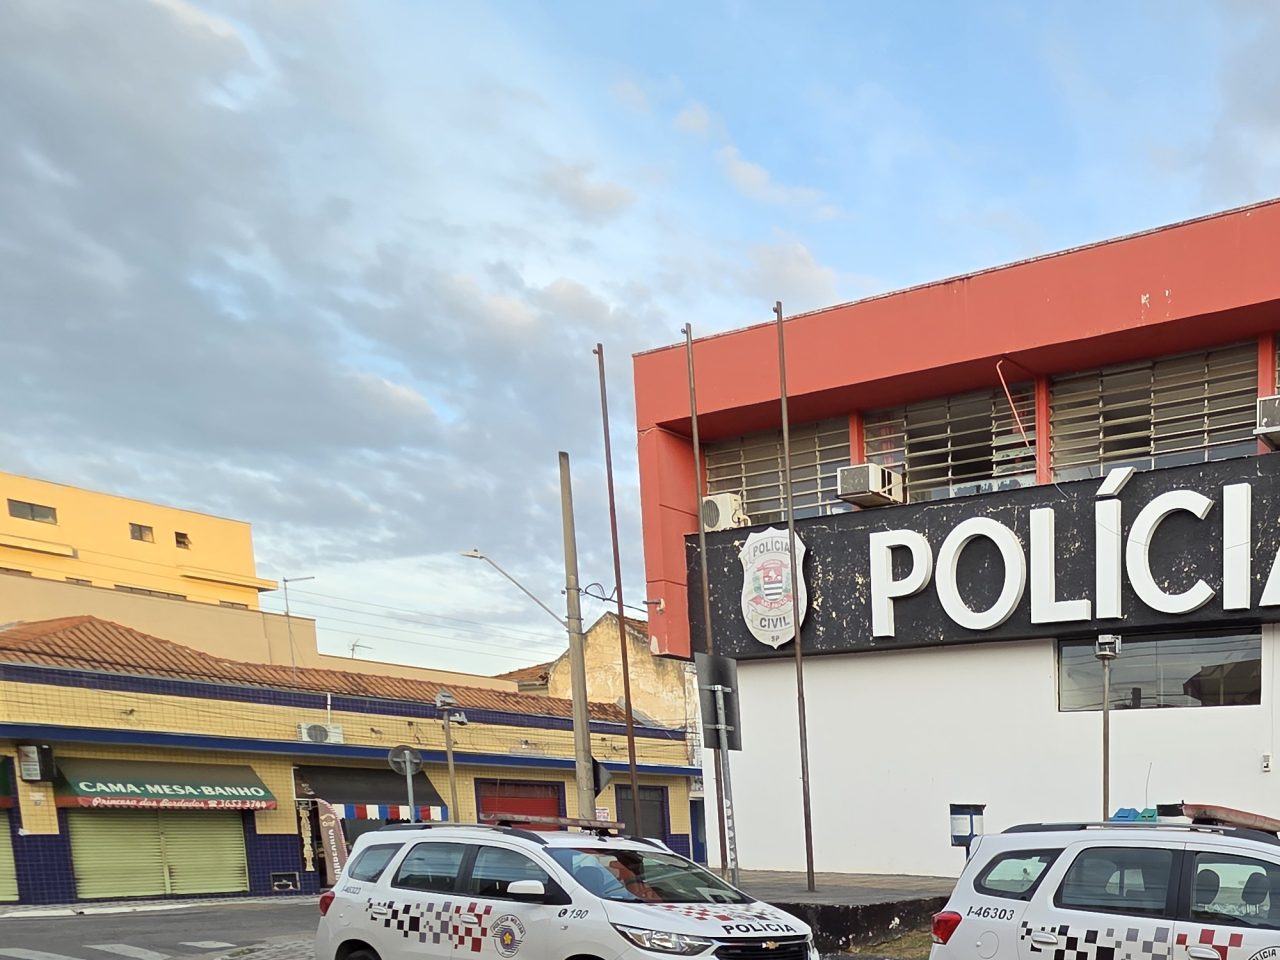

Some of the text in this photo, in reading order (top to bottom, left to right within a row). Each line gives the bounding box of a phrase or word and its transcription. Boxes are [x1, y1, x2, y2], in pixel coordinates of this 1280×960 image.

[752, 537, 790, 557] POLÍCIA
[760, 616, 790, 629] CIVIL
[568, 908, 589, 919] 190
[966, 905, 1015, 921] I-46303
[721, 921, 797, 935] POLÍCIA
